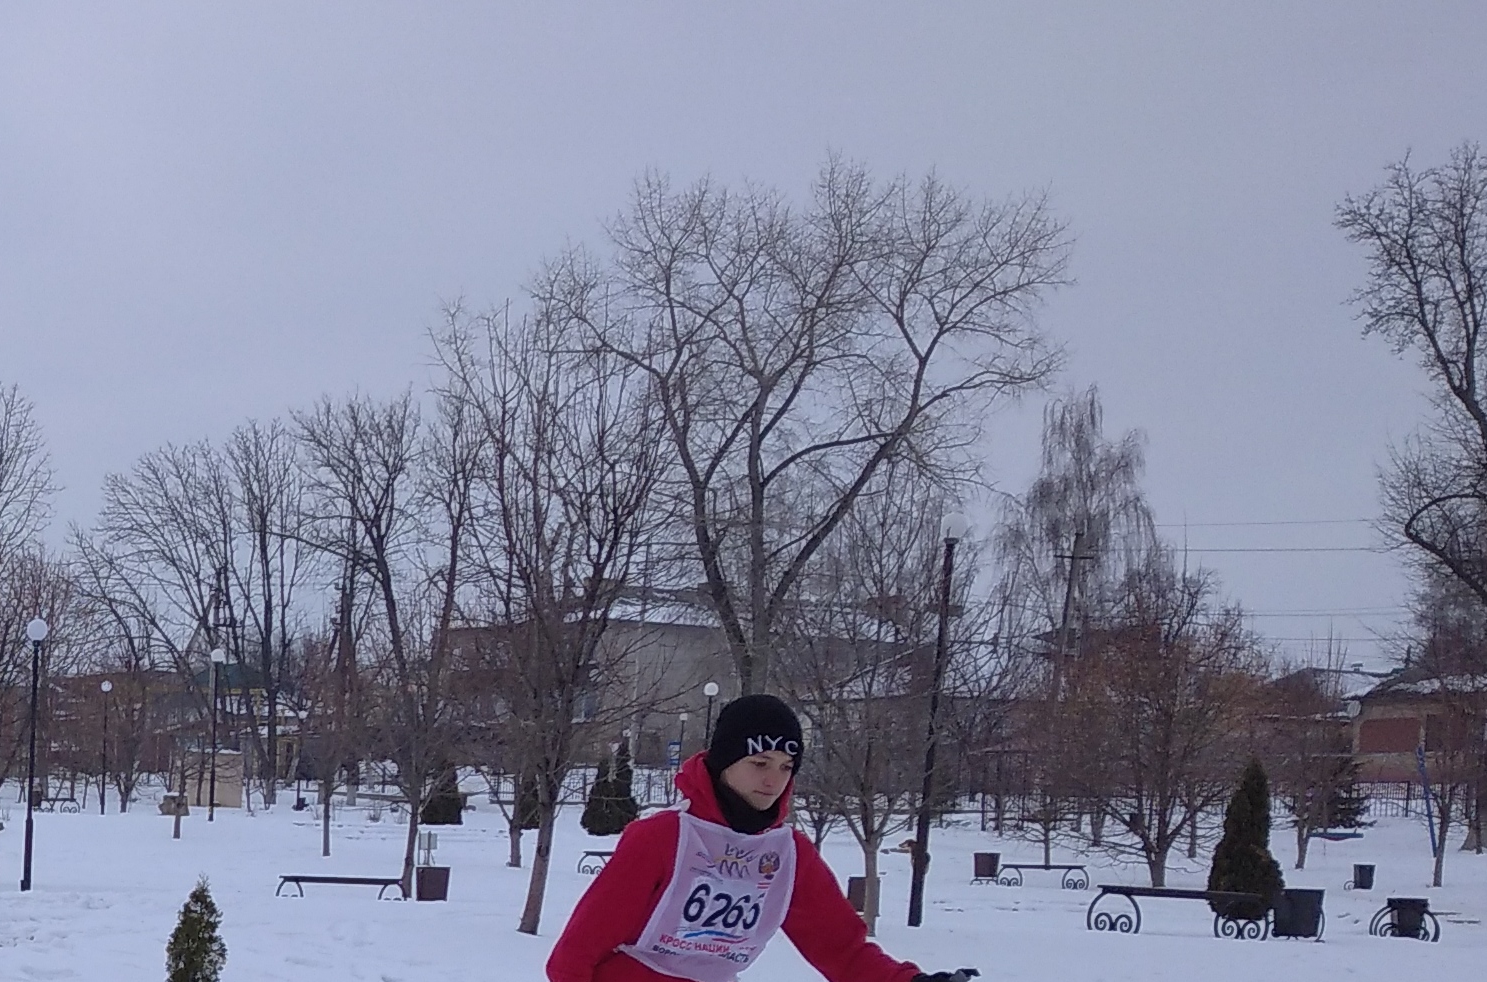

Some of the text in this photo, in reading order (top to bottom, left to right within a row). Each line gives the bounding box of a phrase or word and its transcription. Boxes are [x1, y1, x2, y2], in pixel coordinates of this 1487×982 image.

[747, 735, 798, 755] NYC
[660, 934, 692, 951] КРОСС
[694, 942, 730, 953] НАЦИИ
